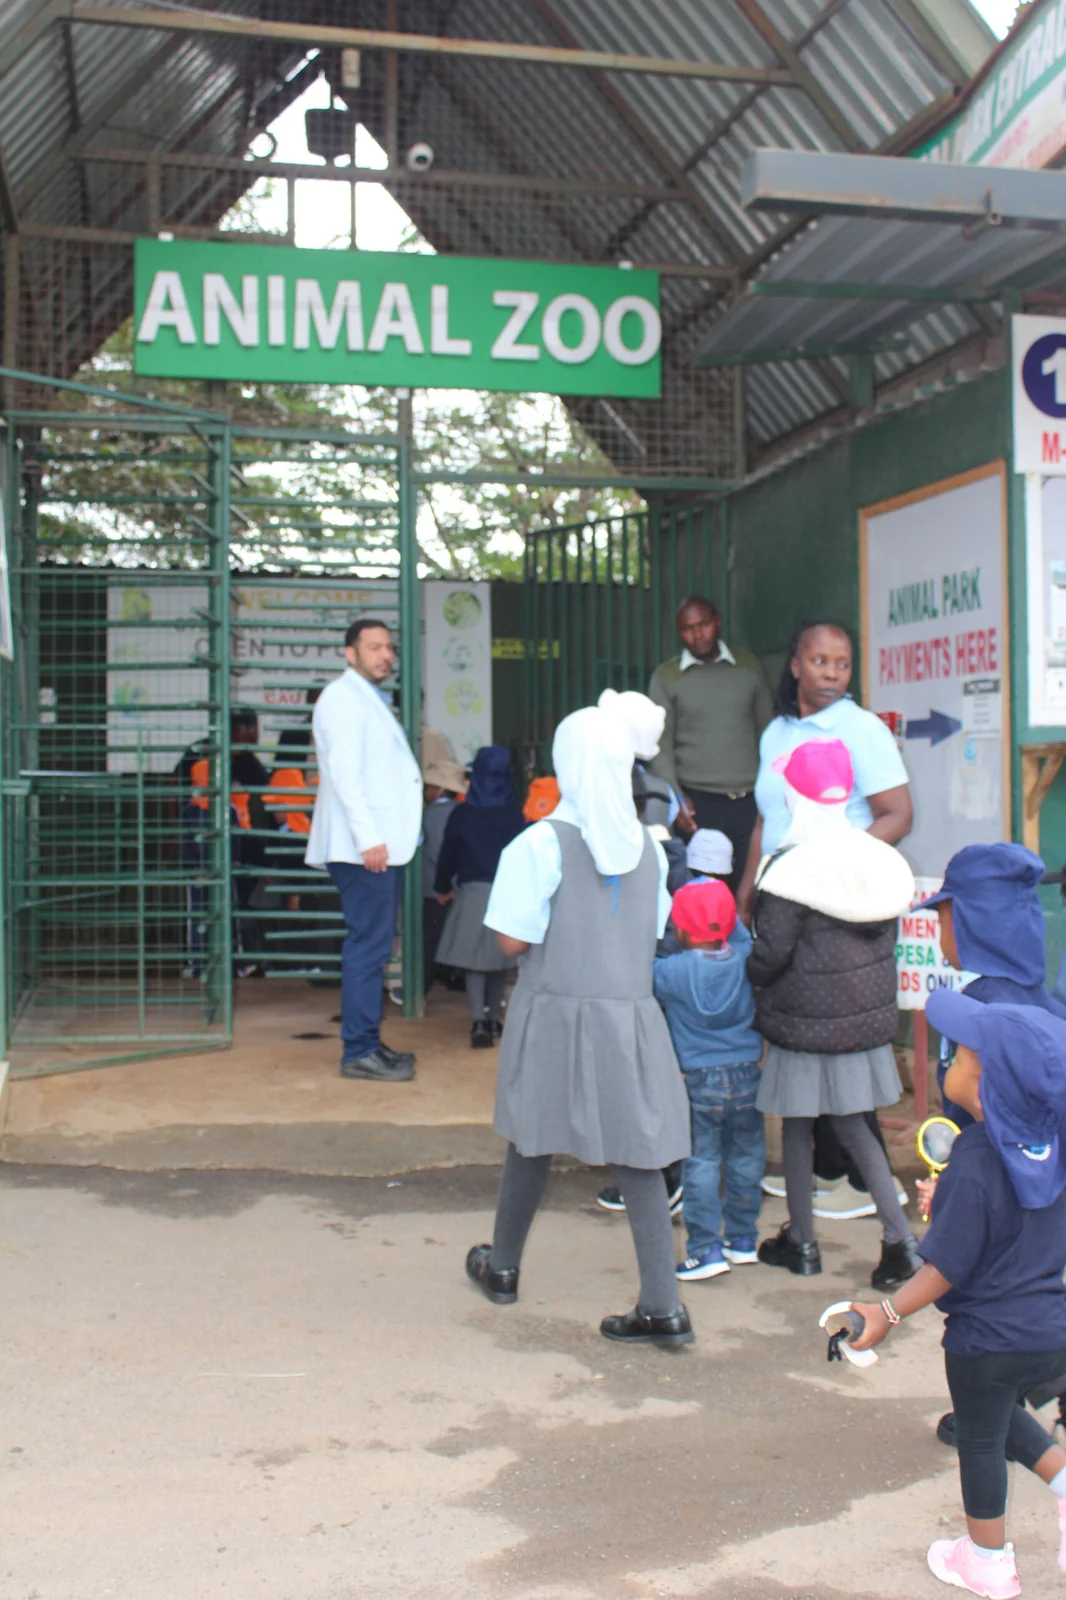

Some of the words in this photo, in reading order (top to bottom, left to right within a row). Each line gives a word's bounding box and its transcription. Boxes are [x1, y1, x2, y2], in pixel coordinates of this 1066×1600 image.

[136, 270, 472, 357] ANIMAL
[490, 289, 662, 366] ZOO
[231, 590, 374, 612] WELCOME
[887, 579, 939, 628] ANIMAL
[942, 566, 982, 617] PARK
[194, 637, 265, 658] OEN
[878, 635, 952, 686] PAYMENTS
[954, 627, 998, 676] HERE
[263, 691, 302, 705] CAU
[901, 917, 939, 939] MEN
[899, 971, 921, 992] DS
